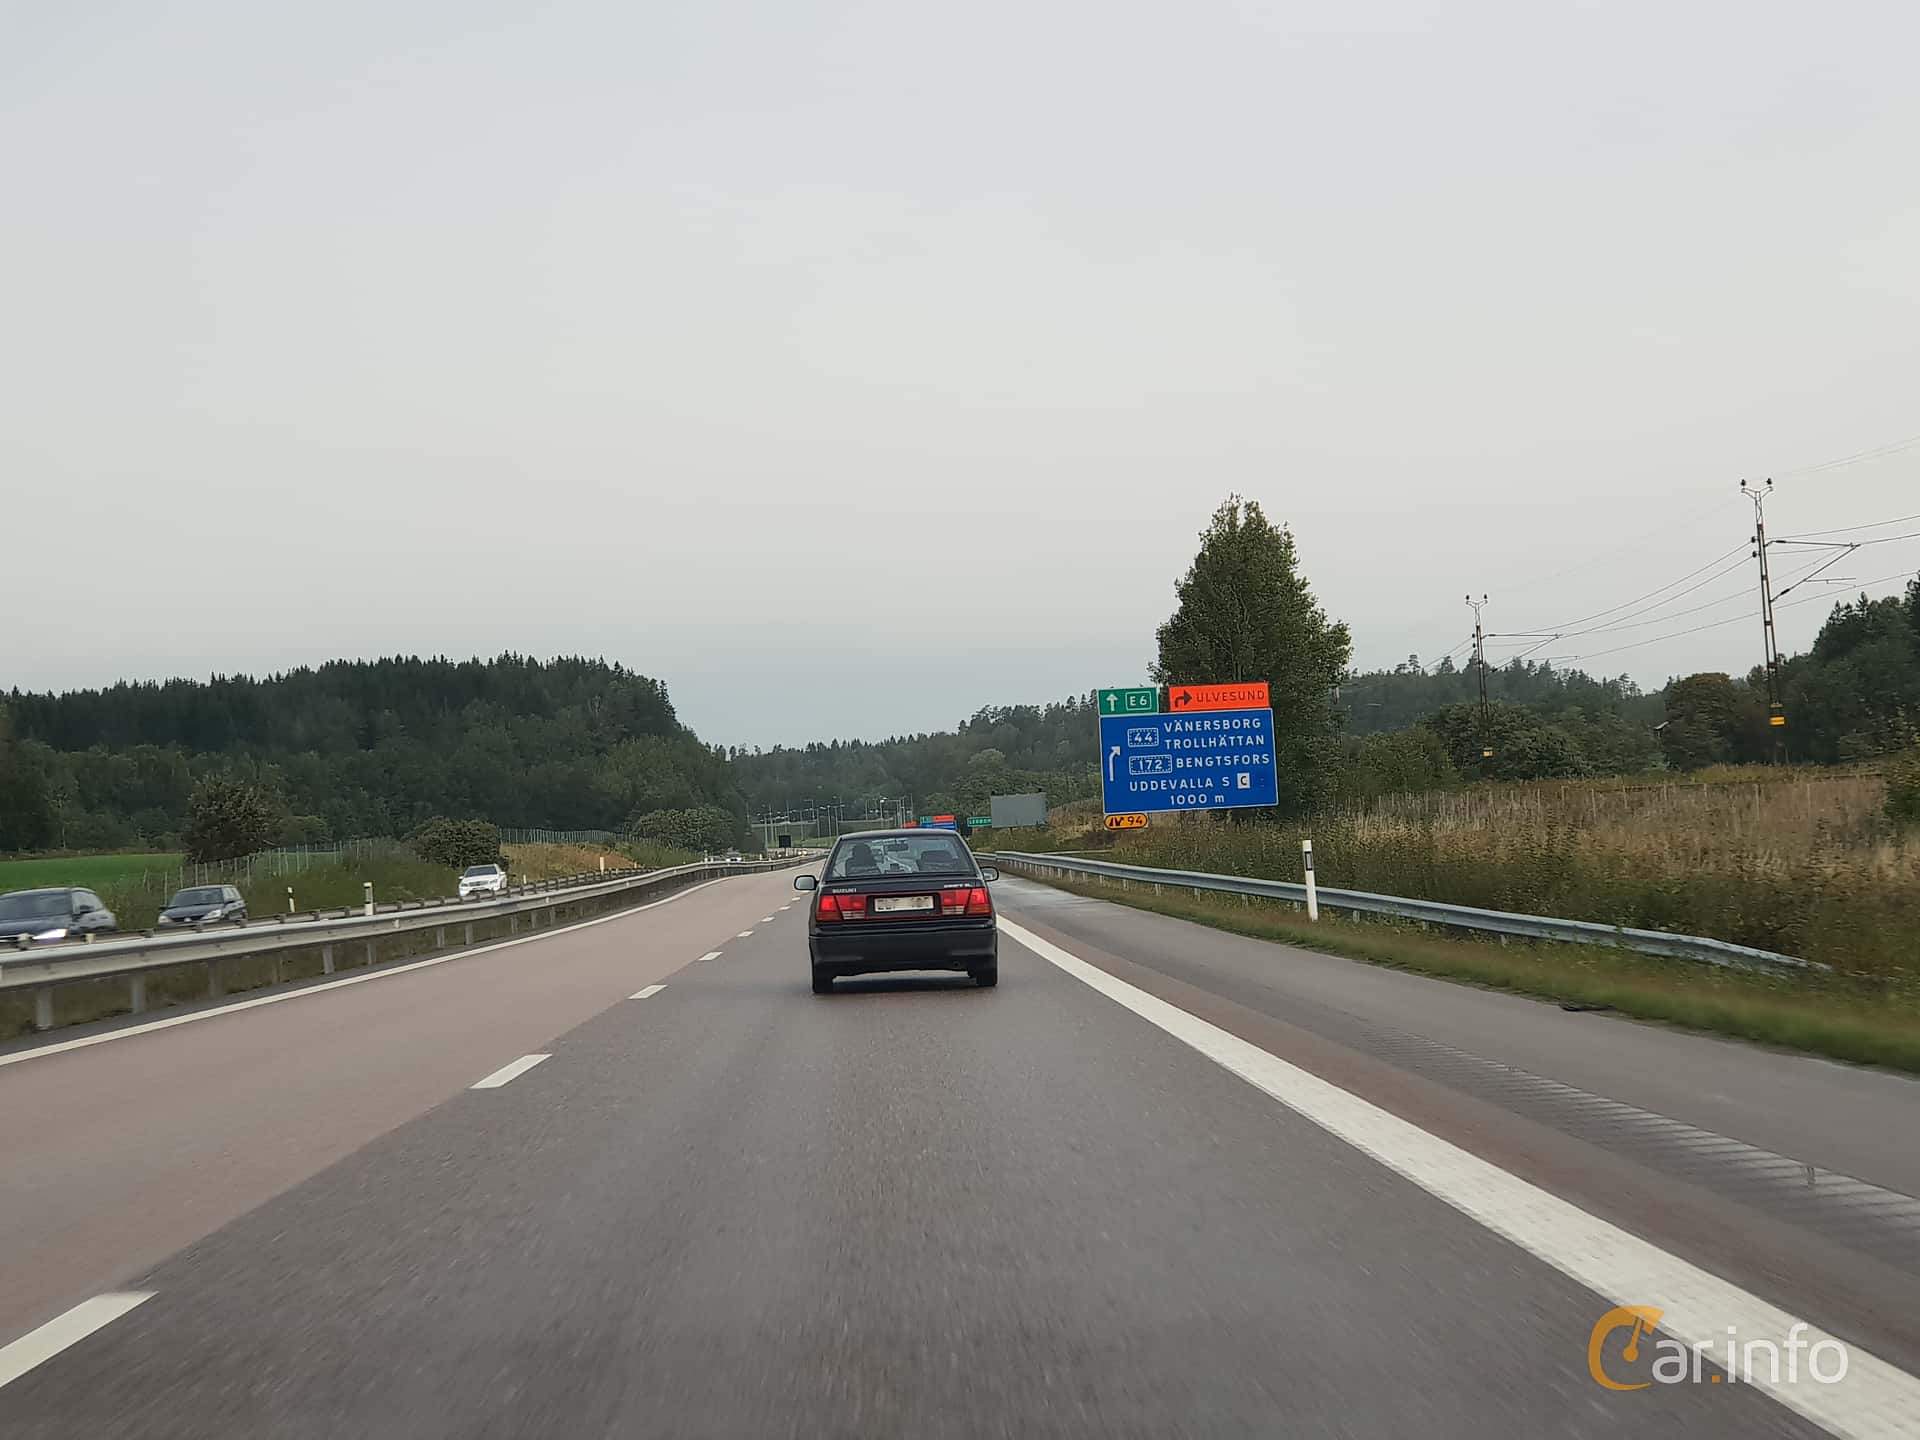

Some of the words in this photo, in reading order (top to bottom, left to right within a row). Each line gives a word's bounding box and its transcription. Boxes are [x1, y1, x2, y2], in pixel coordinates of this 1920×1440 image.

[1128, 694, 1148, 707] E6
[1196, 689, 1265, 703] ULVESUND
[1163, 717, 1261, 733] VÄNERSBORG
[1134, 730, 1153, 742] 44
[1164, 735, 1265, 750] TROLLHÄTTAN
[1138, 758, 1163, 770] 172
[1176, 753, 1270, 769] BENGTSFORS
[1129, 777, 1214, 792] UDDEVALLA
[1222, 776, 1230, 787] S
[1170, 793, 1208, 806] 1000
[1215, 794, 1225, 803] m
[1127, 815, 1143, 826] 94
